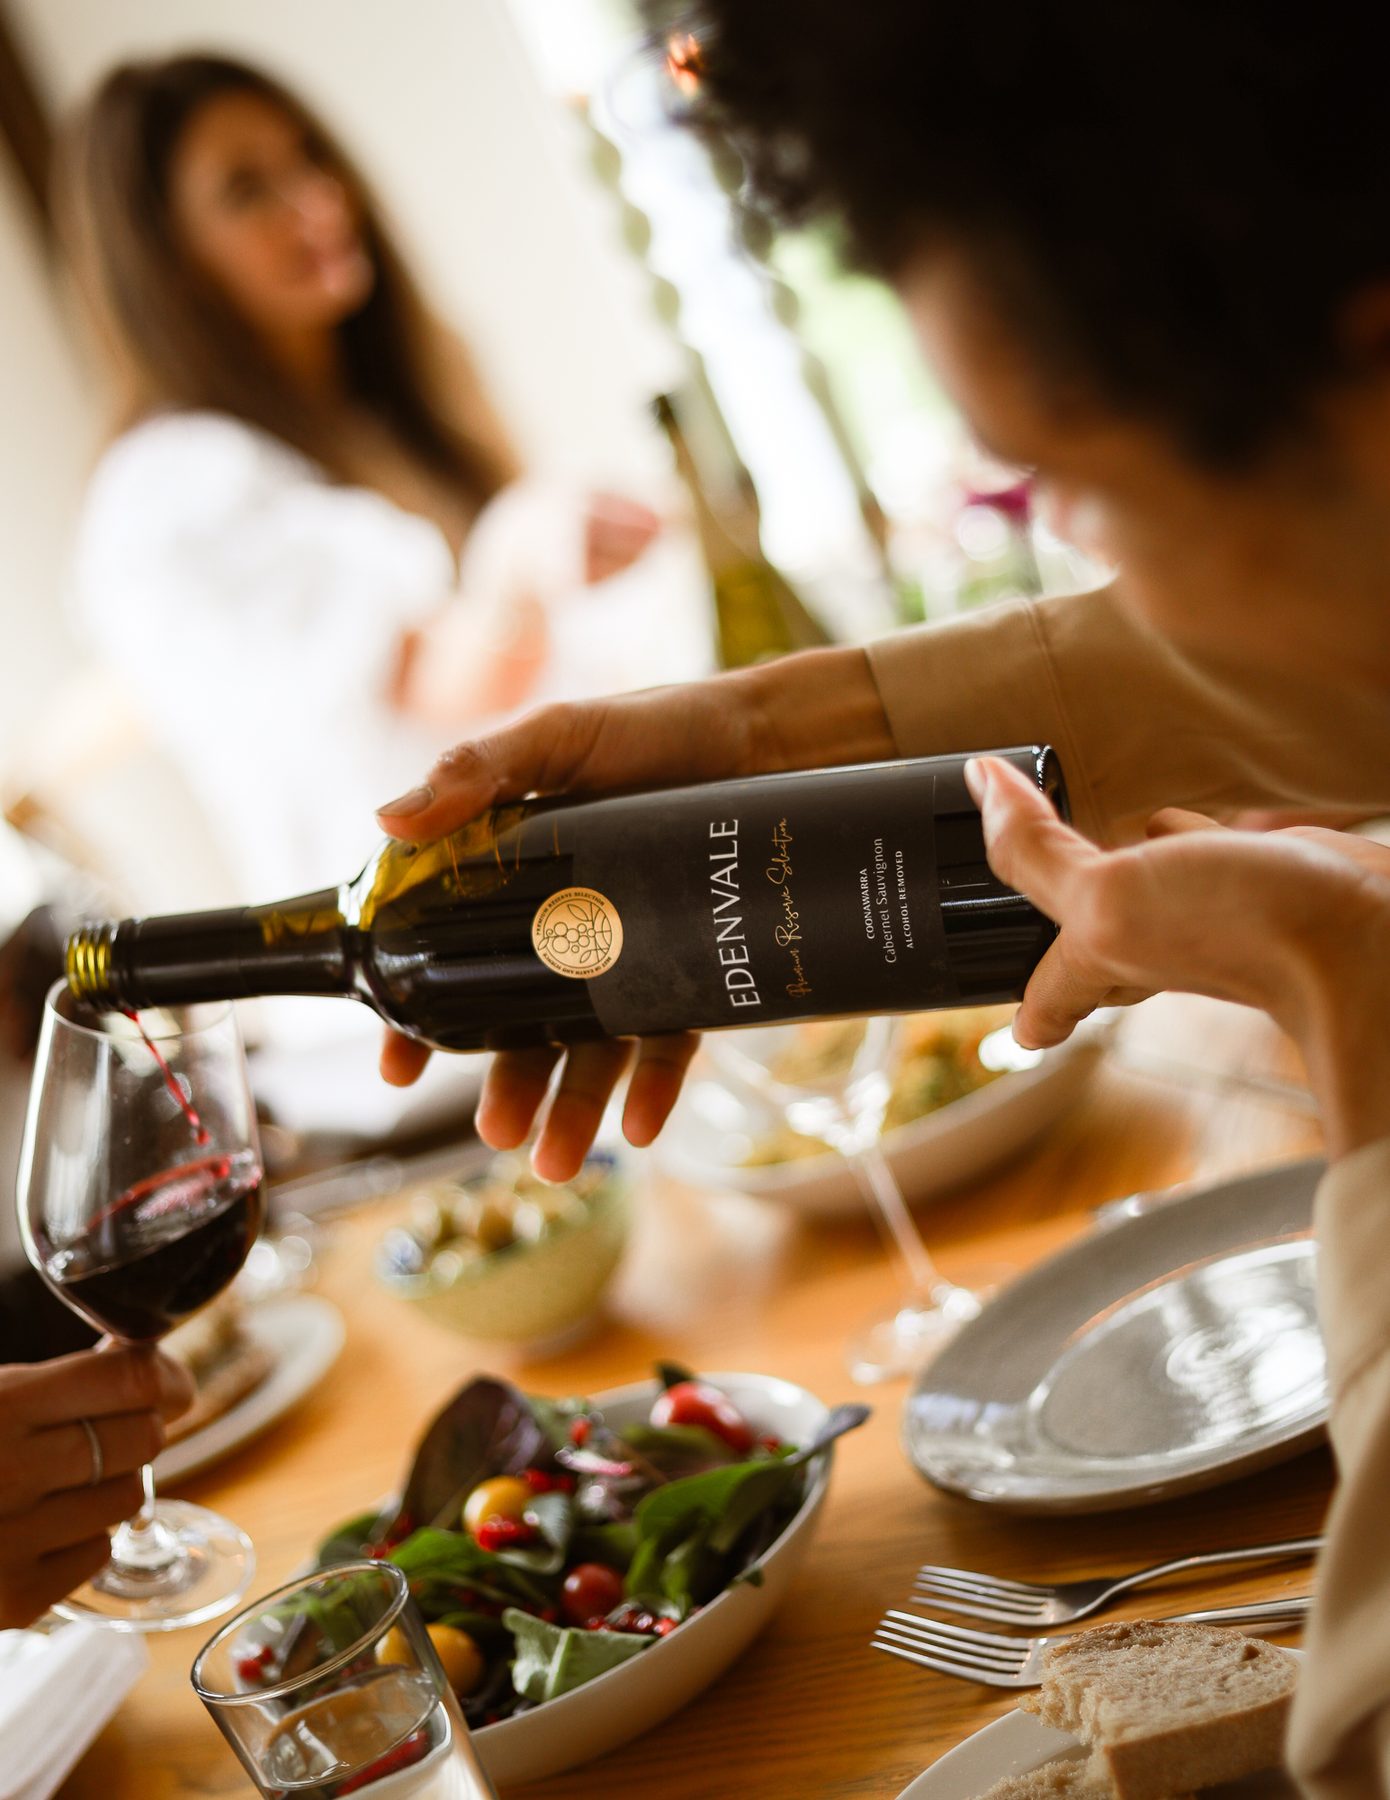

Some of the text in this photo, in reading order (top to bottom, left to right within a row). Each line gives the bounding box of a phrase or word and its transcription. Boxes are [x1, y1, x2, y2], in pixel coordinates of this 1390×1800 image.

[766, 817, 793, 884] Selection
[574, 892, 605, 906] SELECTION
[709, 819, 761, 1007] EDENVALE
[775, 885, 802, 946] Reserve
[859, 868, 875, 940] COONAWARRA
[873, 838, 897, 963] Cabernet Sauvignon
[895, 850, 914, 949] ALCOHOL REMOVED
